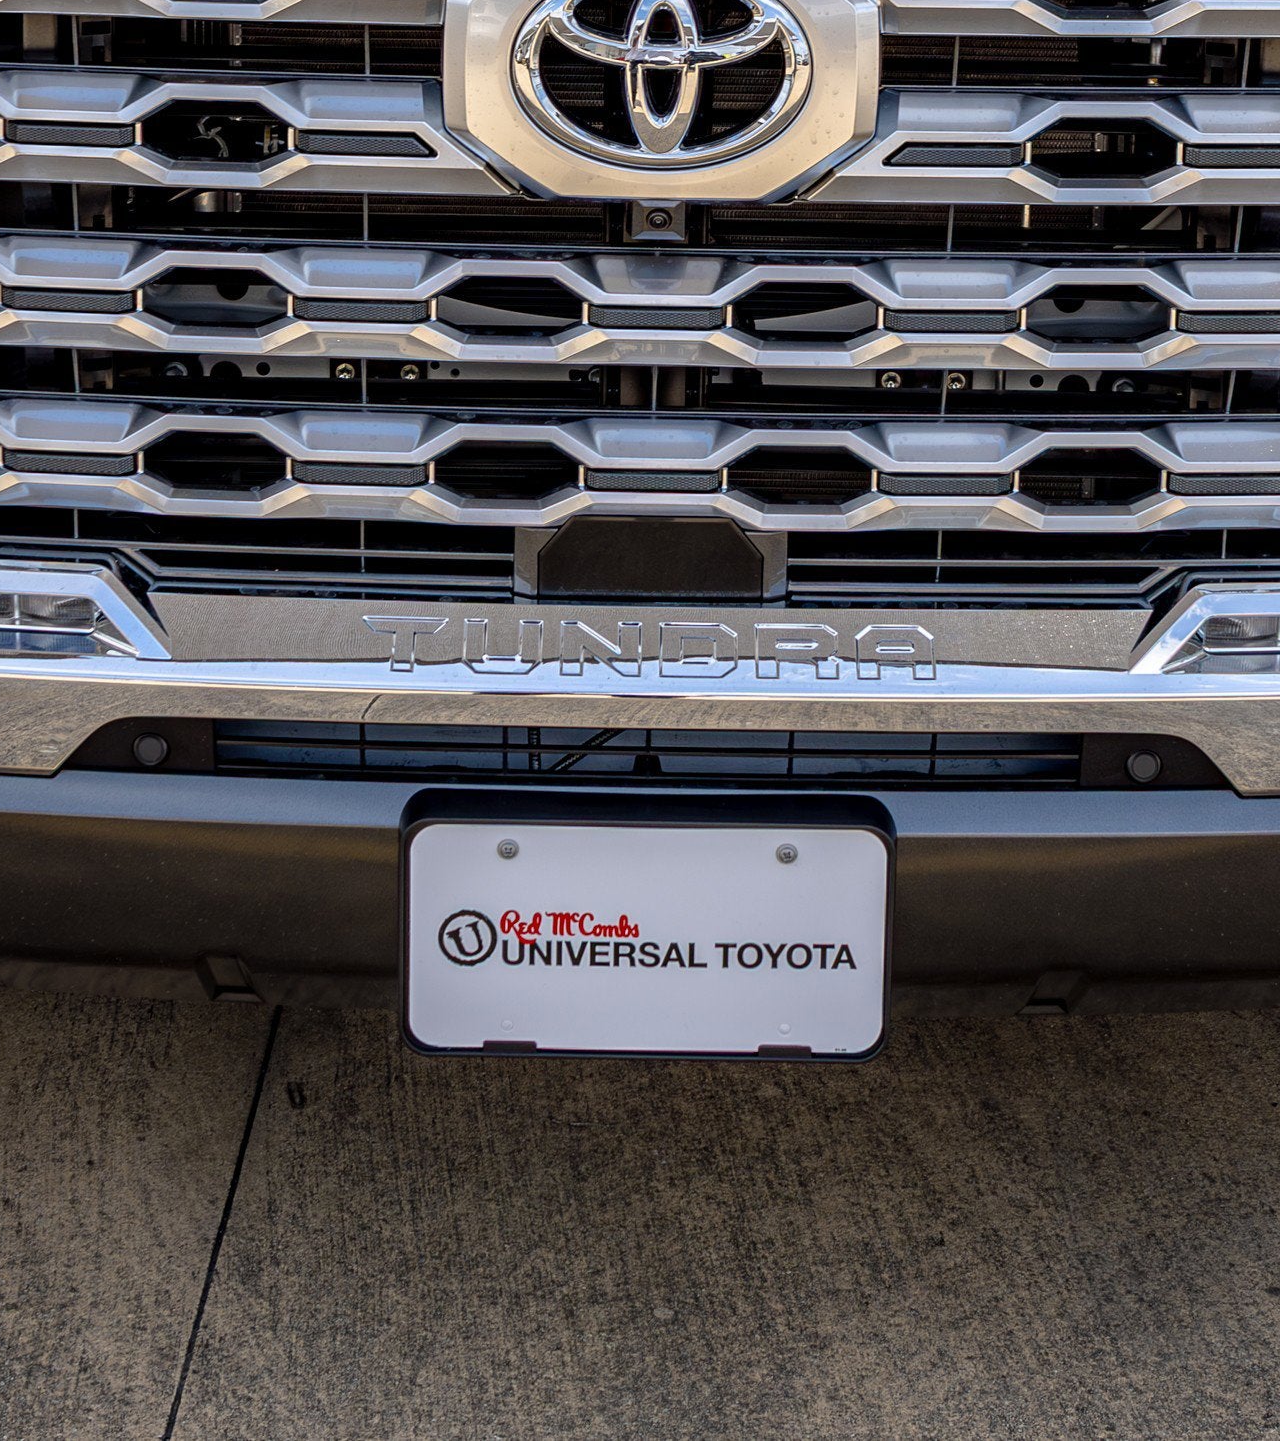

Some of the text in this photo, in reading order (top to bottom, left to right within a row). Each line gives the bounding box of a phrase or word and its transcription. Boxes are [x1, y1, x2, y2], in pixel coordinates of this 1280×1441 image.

[362, 615, 937, 680] TUNDRA
[500, 909, 640, 945] Red McCombs
[502, 939, 857, 970] UNIVERSAL TOYOTA
